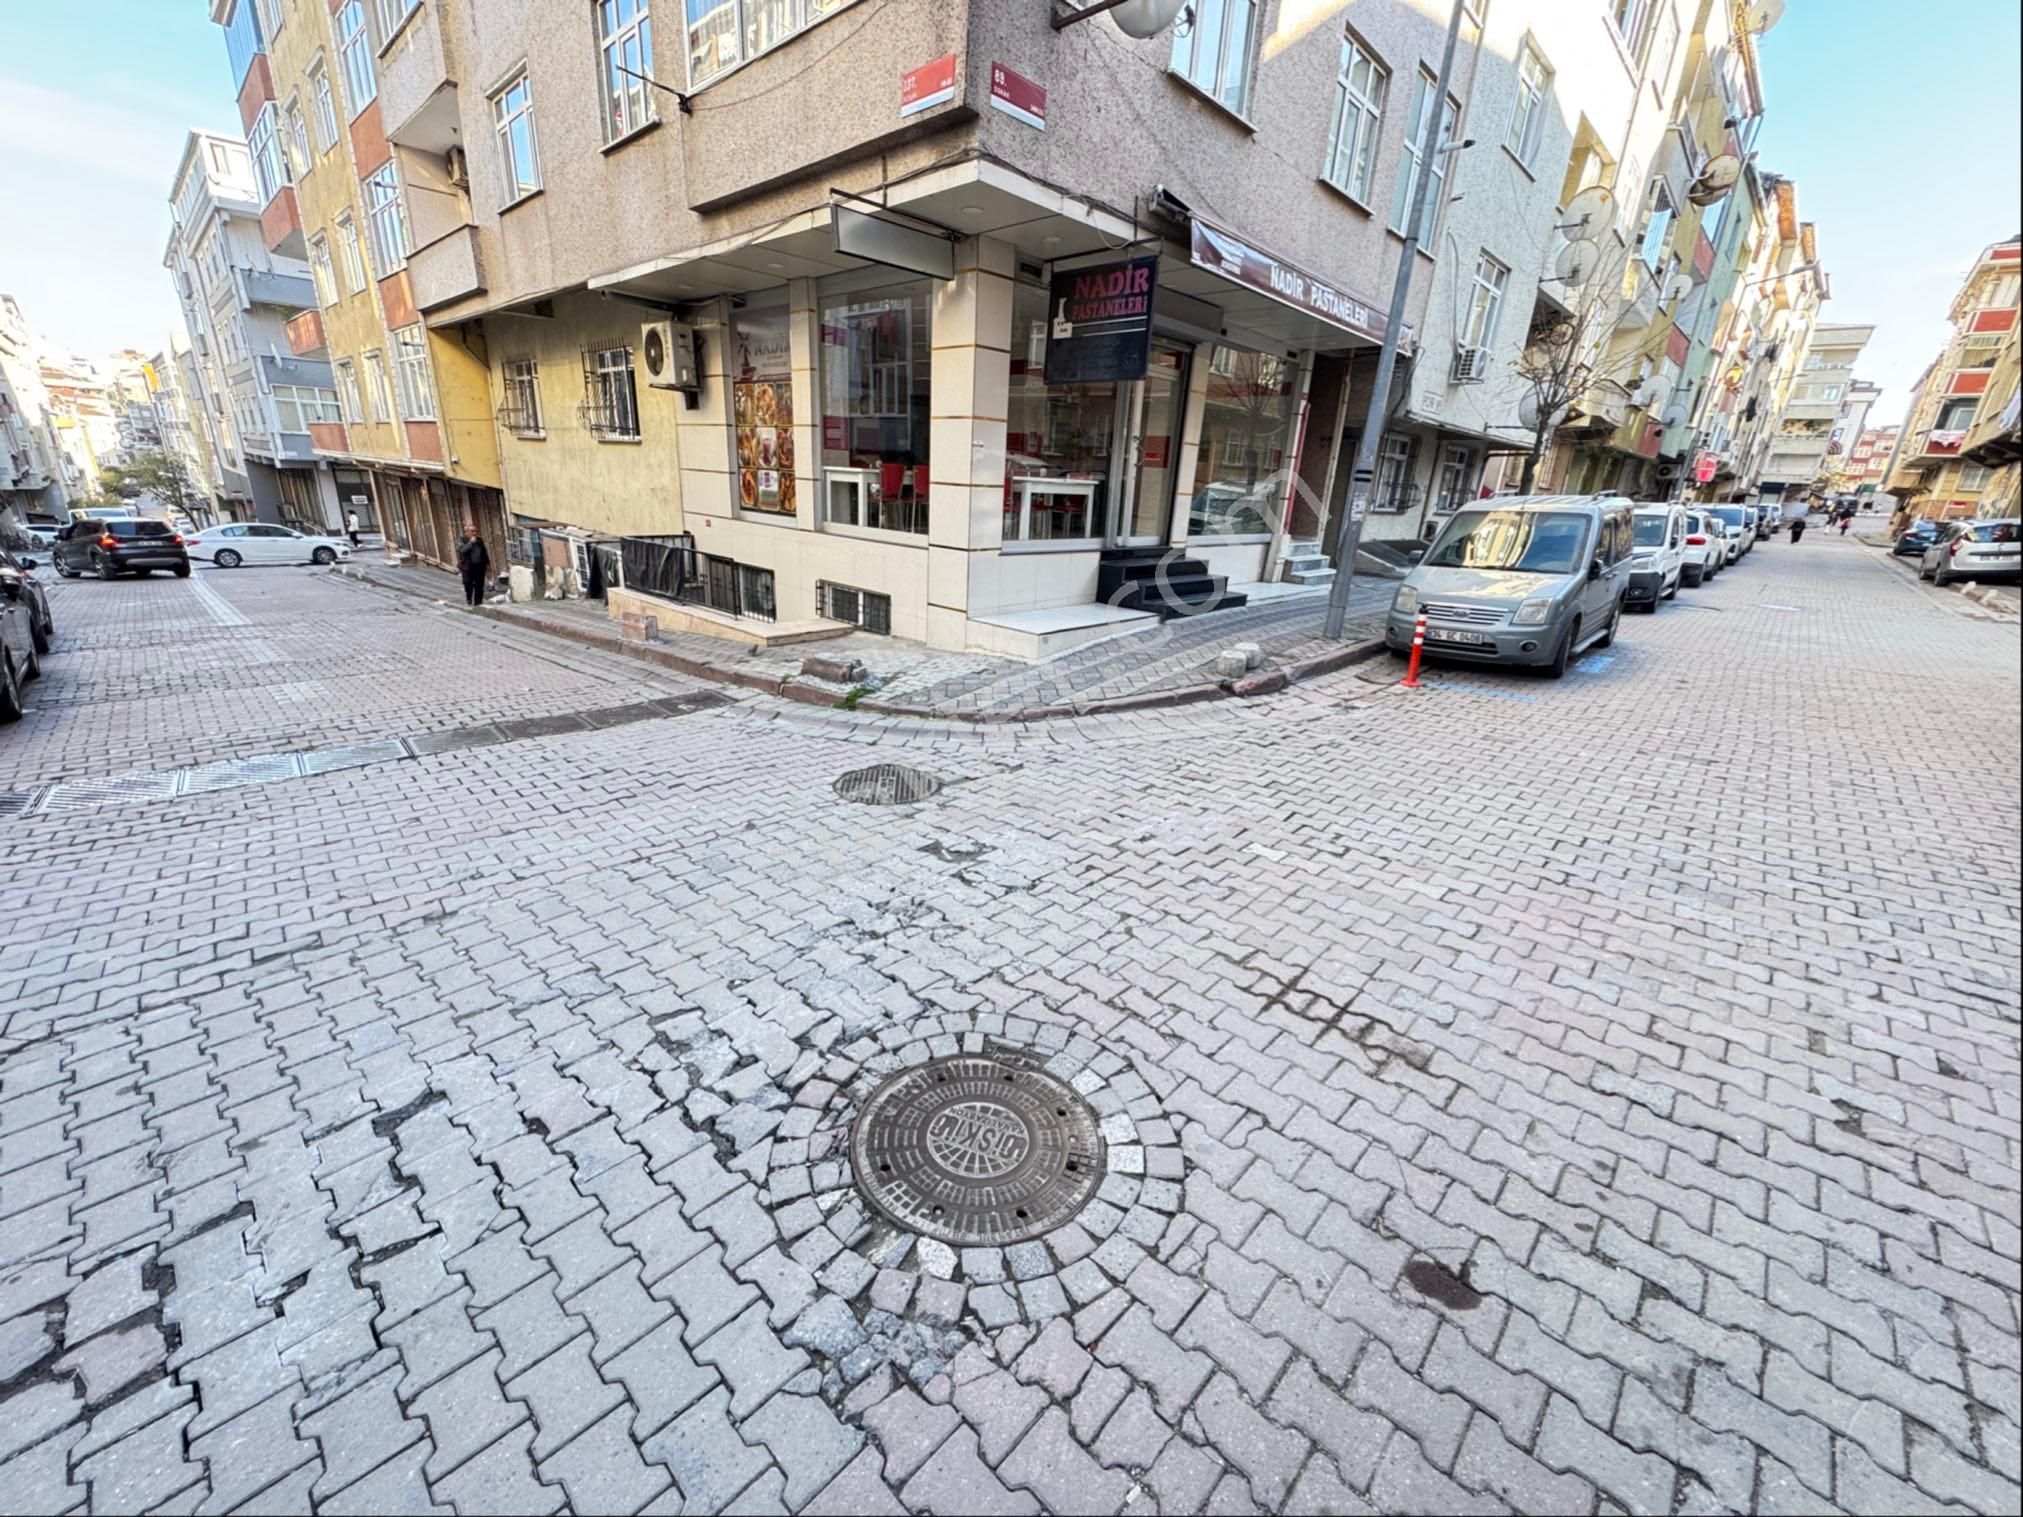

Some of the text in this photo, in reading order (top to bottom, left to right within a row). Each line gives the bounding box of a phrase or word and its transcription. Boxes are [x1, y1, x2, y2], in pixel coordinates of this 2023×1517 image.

[1075, 264, 1149, 299] NADİR
[1270, 265, 1304, 301] NADİR
[1072, 295, 1148, 320] PASTANELERİ
